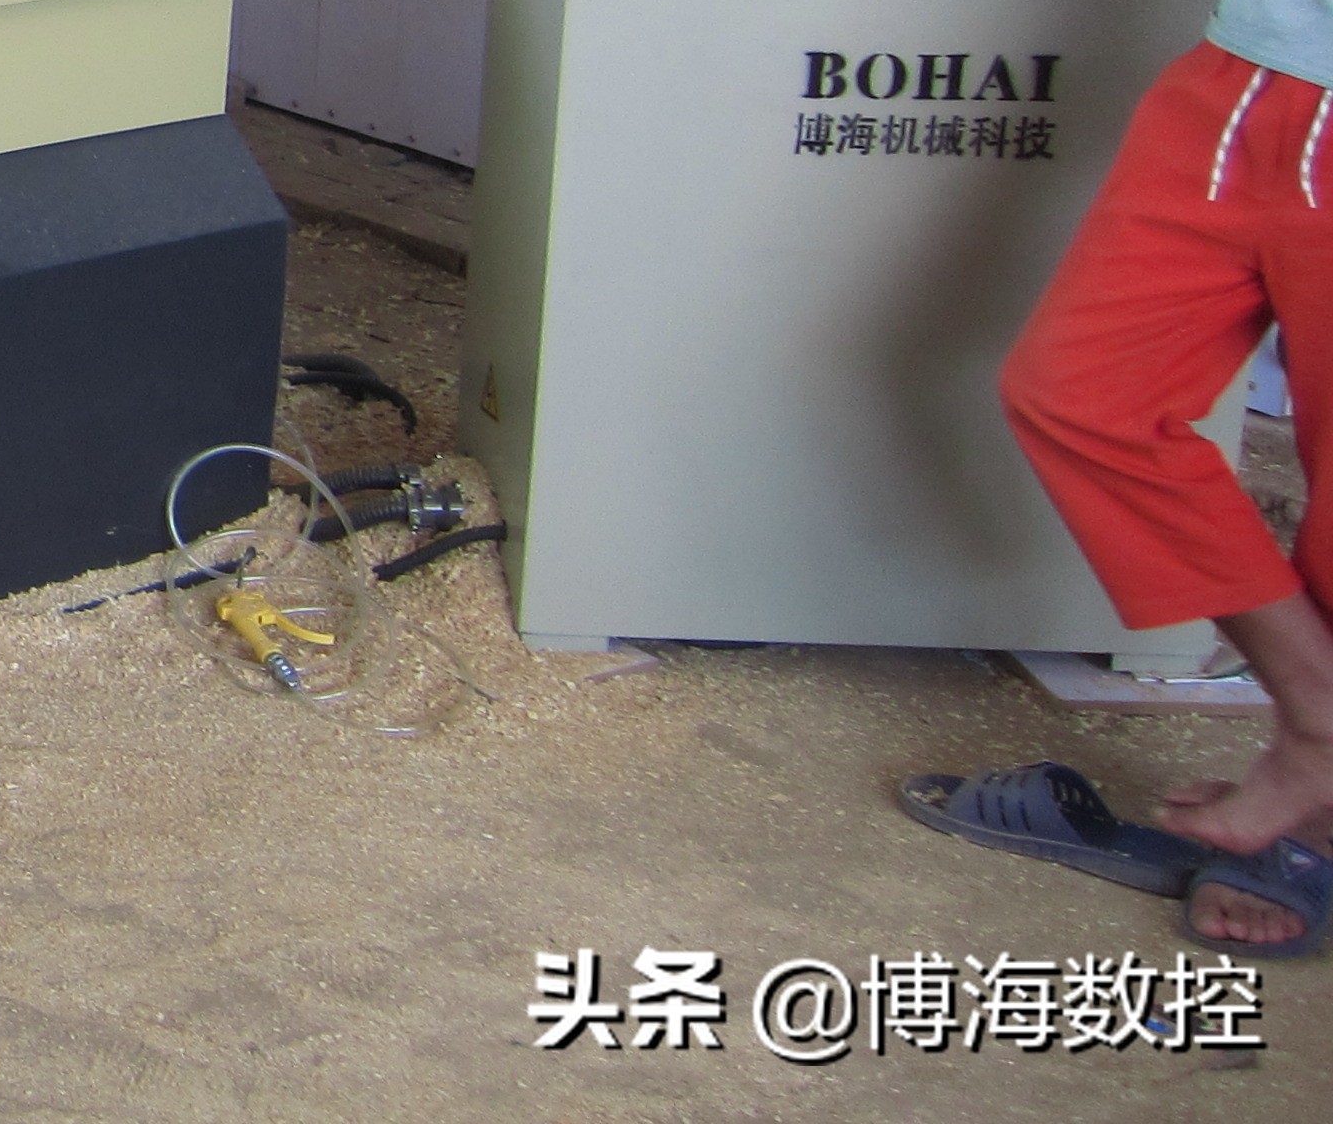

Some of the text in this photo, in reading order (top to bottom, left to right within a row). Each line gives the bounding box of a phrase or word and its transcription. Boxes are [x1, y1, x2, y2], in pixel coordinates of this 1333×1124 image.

[801, 51, 1061, 102] BOHAI
[794, 112, 1057, 159] 博海机械科技
